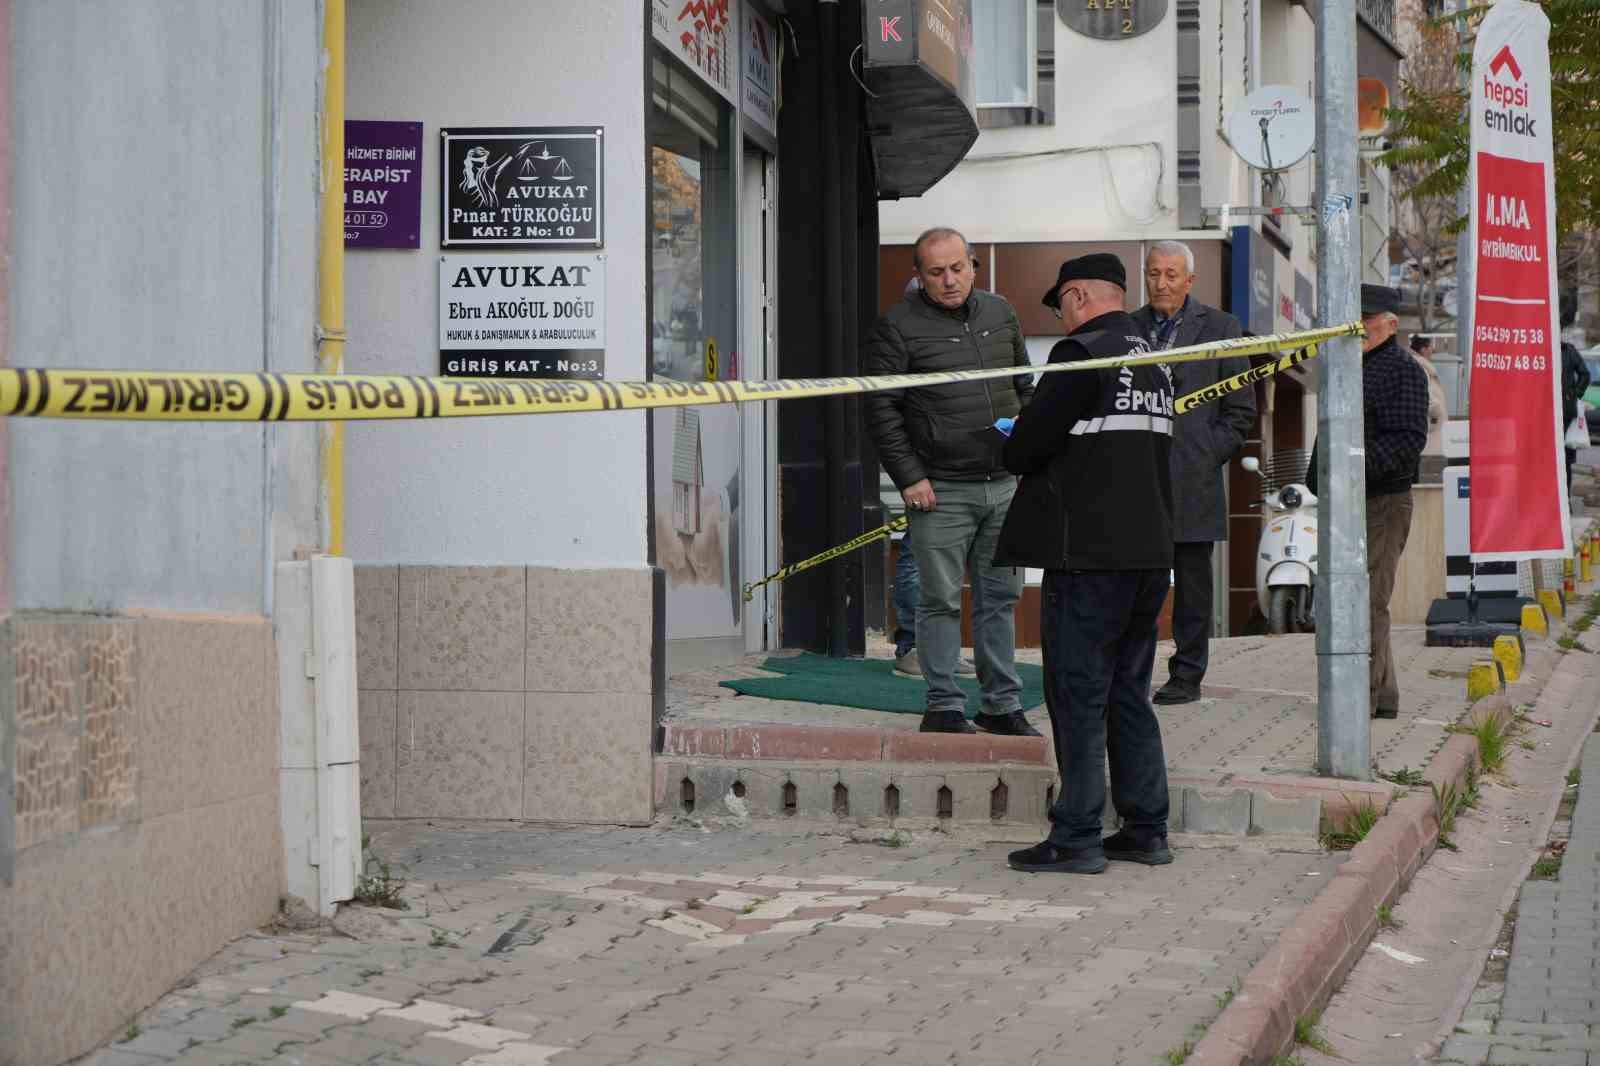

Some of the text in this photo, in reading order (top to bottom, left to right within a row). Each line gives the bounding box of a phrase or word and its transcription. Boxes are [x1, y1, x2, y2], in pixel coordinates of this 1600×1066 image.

[1122, 19, 1133, 33] 2
[1484, 74, 1528, 108] hepsi
[1485, 109, 1537, 138] emlak
[348, 146, 416, 160] HİZMET BİRİMİ
[353, 189, 389, 204] BAY
[506, 185, 589, 199] AVUKAT
[353, 213, 366, 225] 01
[369, 214, 384, 225] 52
[452, 203, 593, 223] Pınar TÜRKOĞLU
[472, 226, 575, 237] KAT: 2 No: 10
[452, 266, 591, 288] AVUKAT
[448, 296, 595, 319] Ebru AKOĞUL DOĞU
[447, 329, 474, 341] HUKUK
[481, 329, 530, 343] DANIŞMANLIK
[539, 328, 597, 340] ARABULUCULUK
[1512, 328, 1527, 345] 75
[1529, 328, 1544, 345] 38
[447, 358, 499, 375] GİRİŞ
[504, 360, 541, 372] KAT
[556, 360, 598, 372] No:3
[1514, 354, 1530, 371] 48
[1532, 354, 1546, 371] 63
[63, 376, 250, 413] GİRİLMEZ
[301, 378, 406, 411] POLİS
[443, 380, 590, 407] GİRİLMEZ
